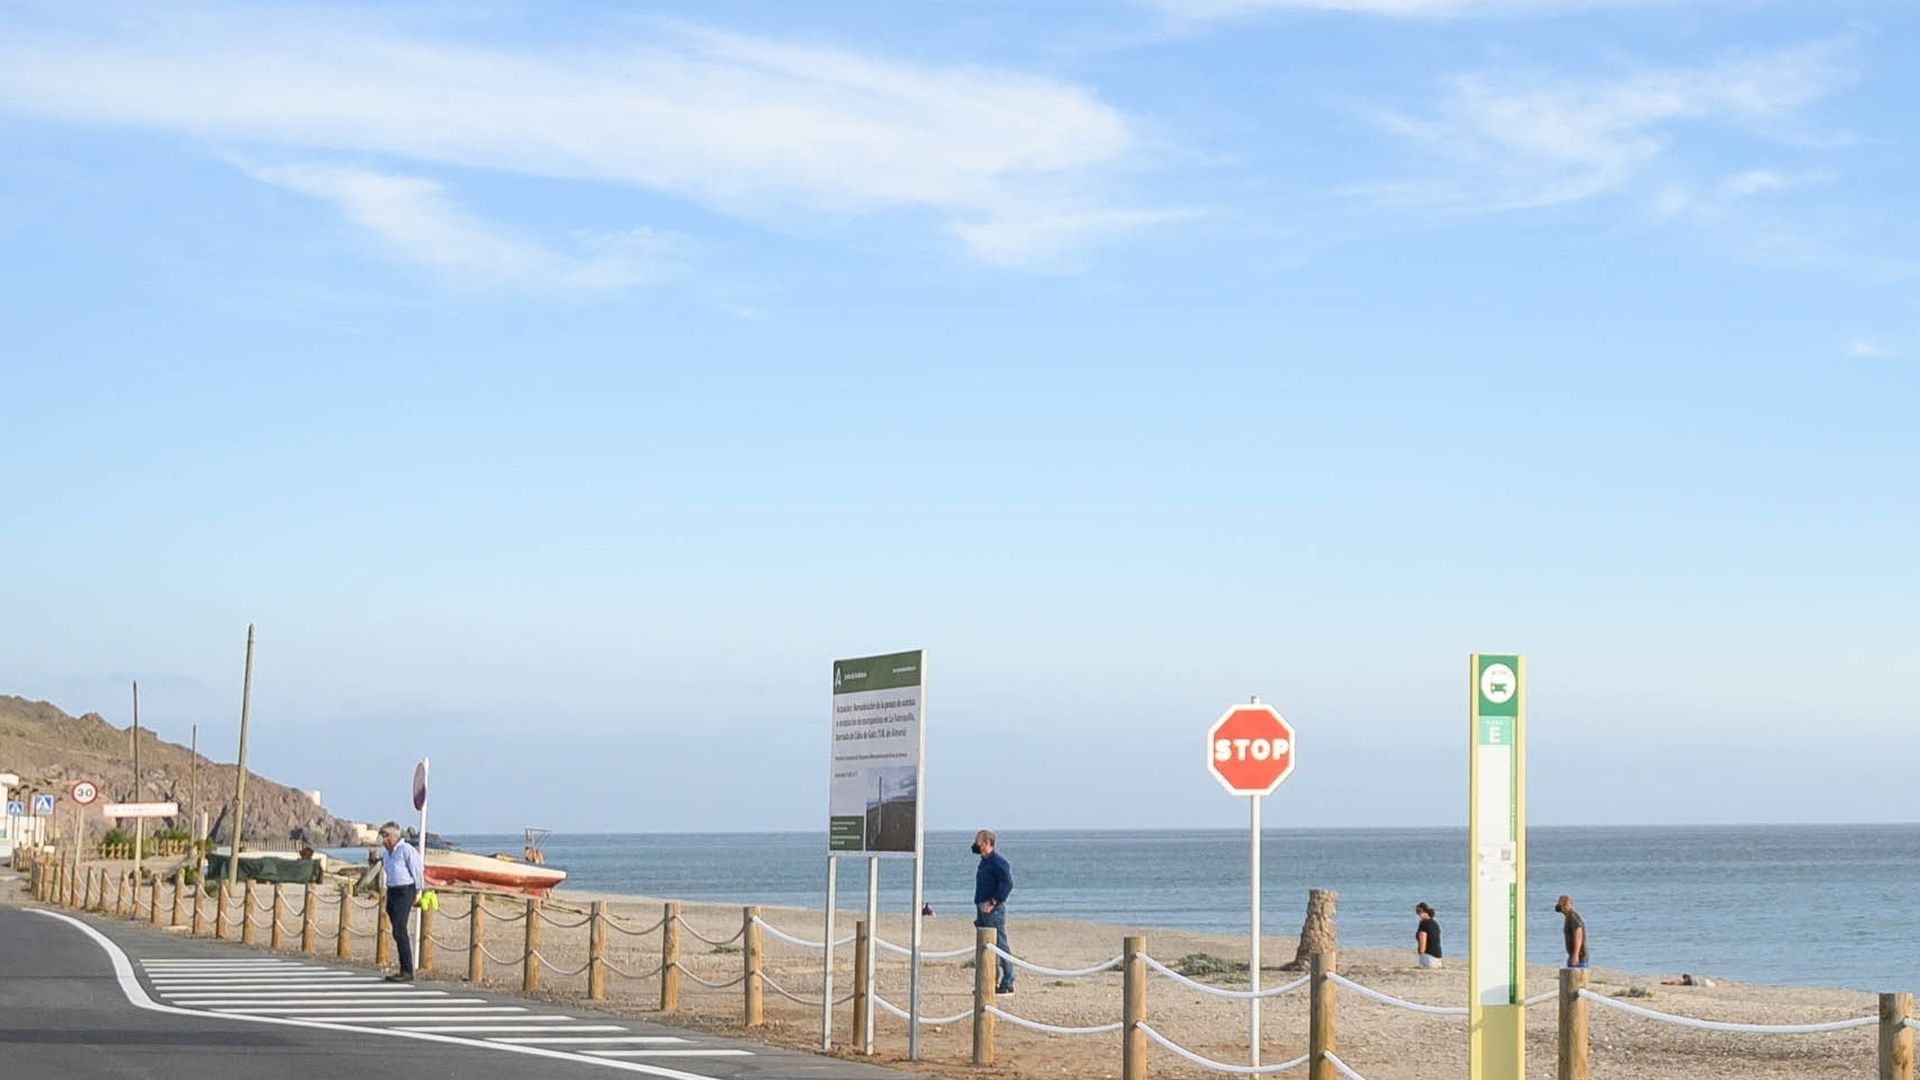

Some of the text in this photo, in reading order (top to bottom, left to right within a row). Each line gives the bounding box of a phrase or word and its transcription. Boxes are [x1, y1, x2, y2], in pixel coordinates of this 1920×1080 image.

[1488, 727, 1501, 743] E
[1214, 738, 1289, 762] STOP
[77, 788, 93, 798] 30
